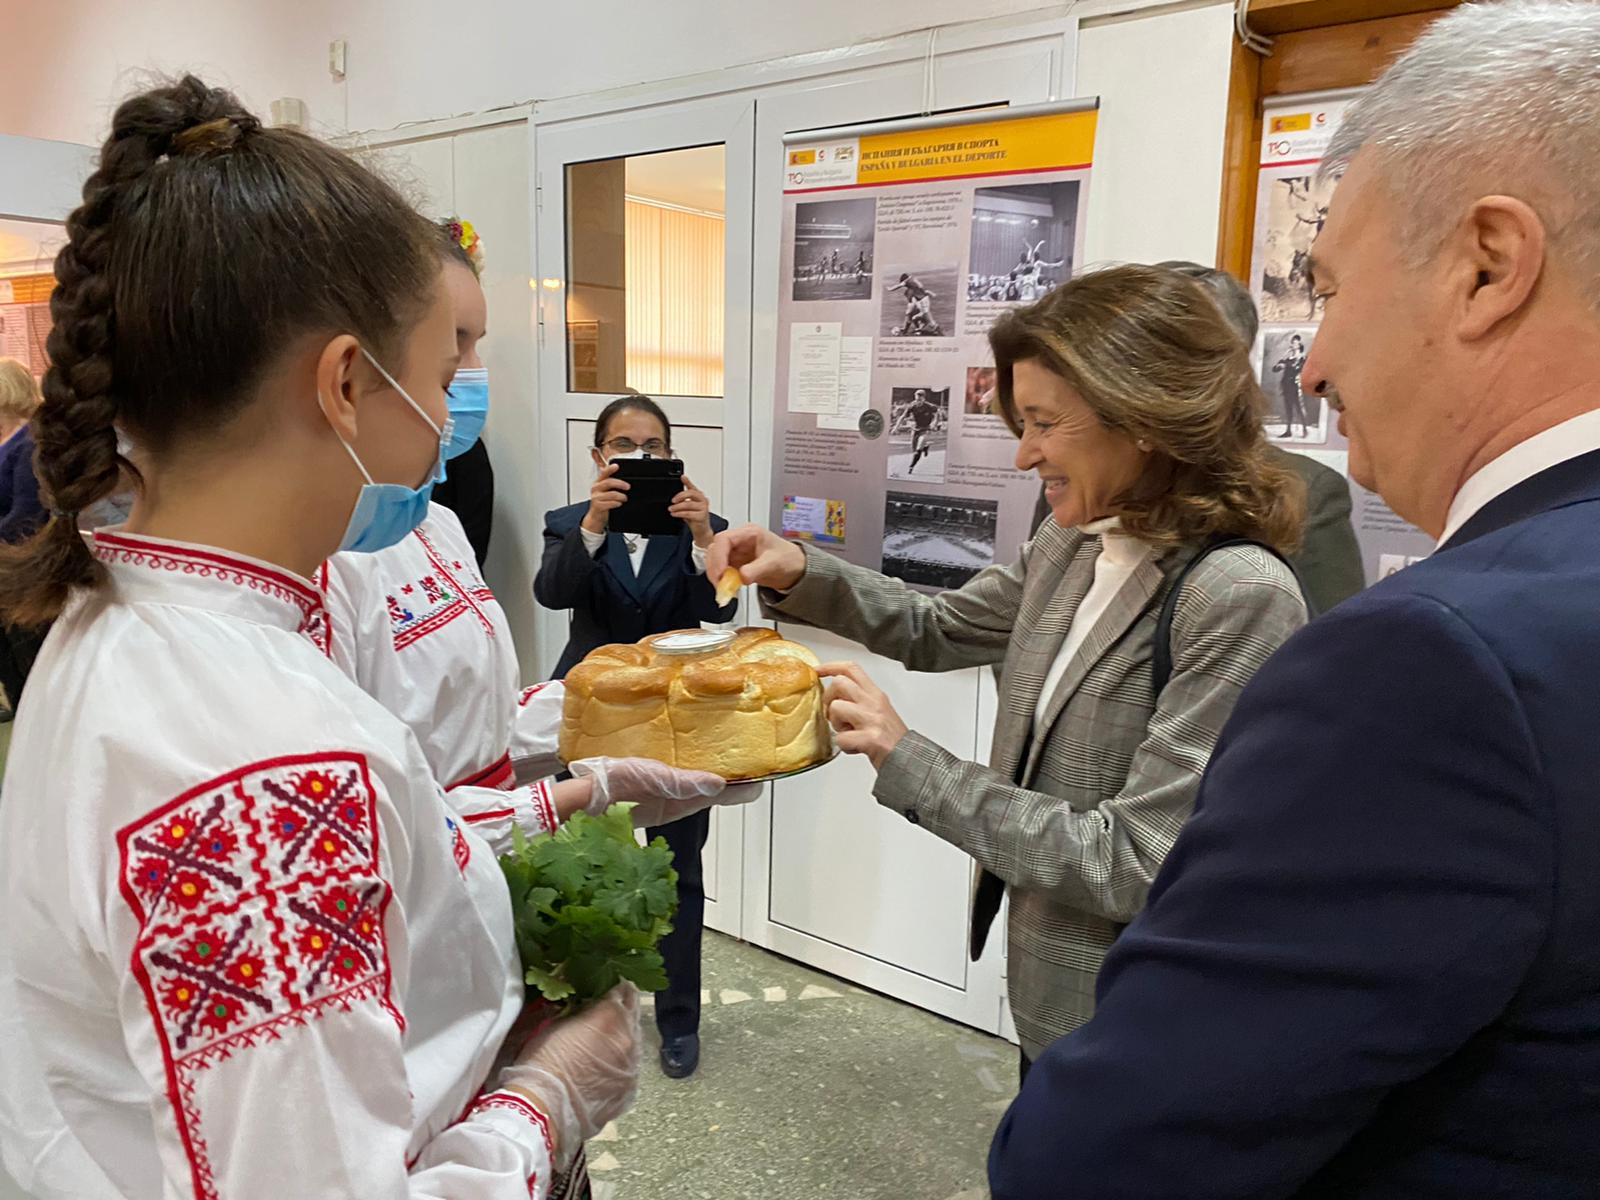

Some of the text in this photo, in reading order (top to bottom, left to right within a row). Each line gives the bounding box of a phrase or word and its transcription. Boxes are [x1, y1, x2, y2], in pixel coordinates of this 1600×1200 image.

[862, 139, 999, 160] ИСПАНИЯ И БЪЛГАРИЯ В СПОРТА
[861, 161, 890, 172] ESPAÑA
[898, 157, 940, 168] BULGARIA
[940, 155, 952, 164] EN
[953, 154, 964, 163] EL
[965, 151, 1007, 161] DEPORTE
